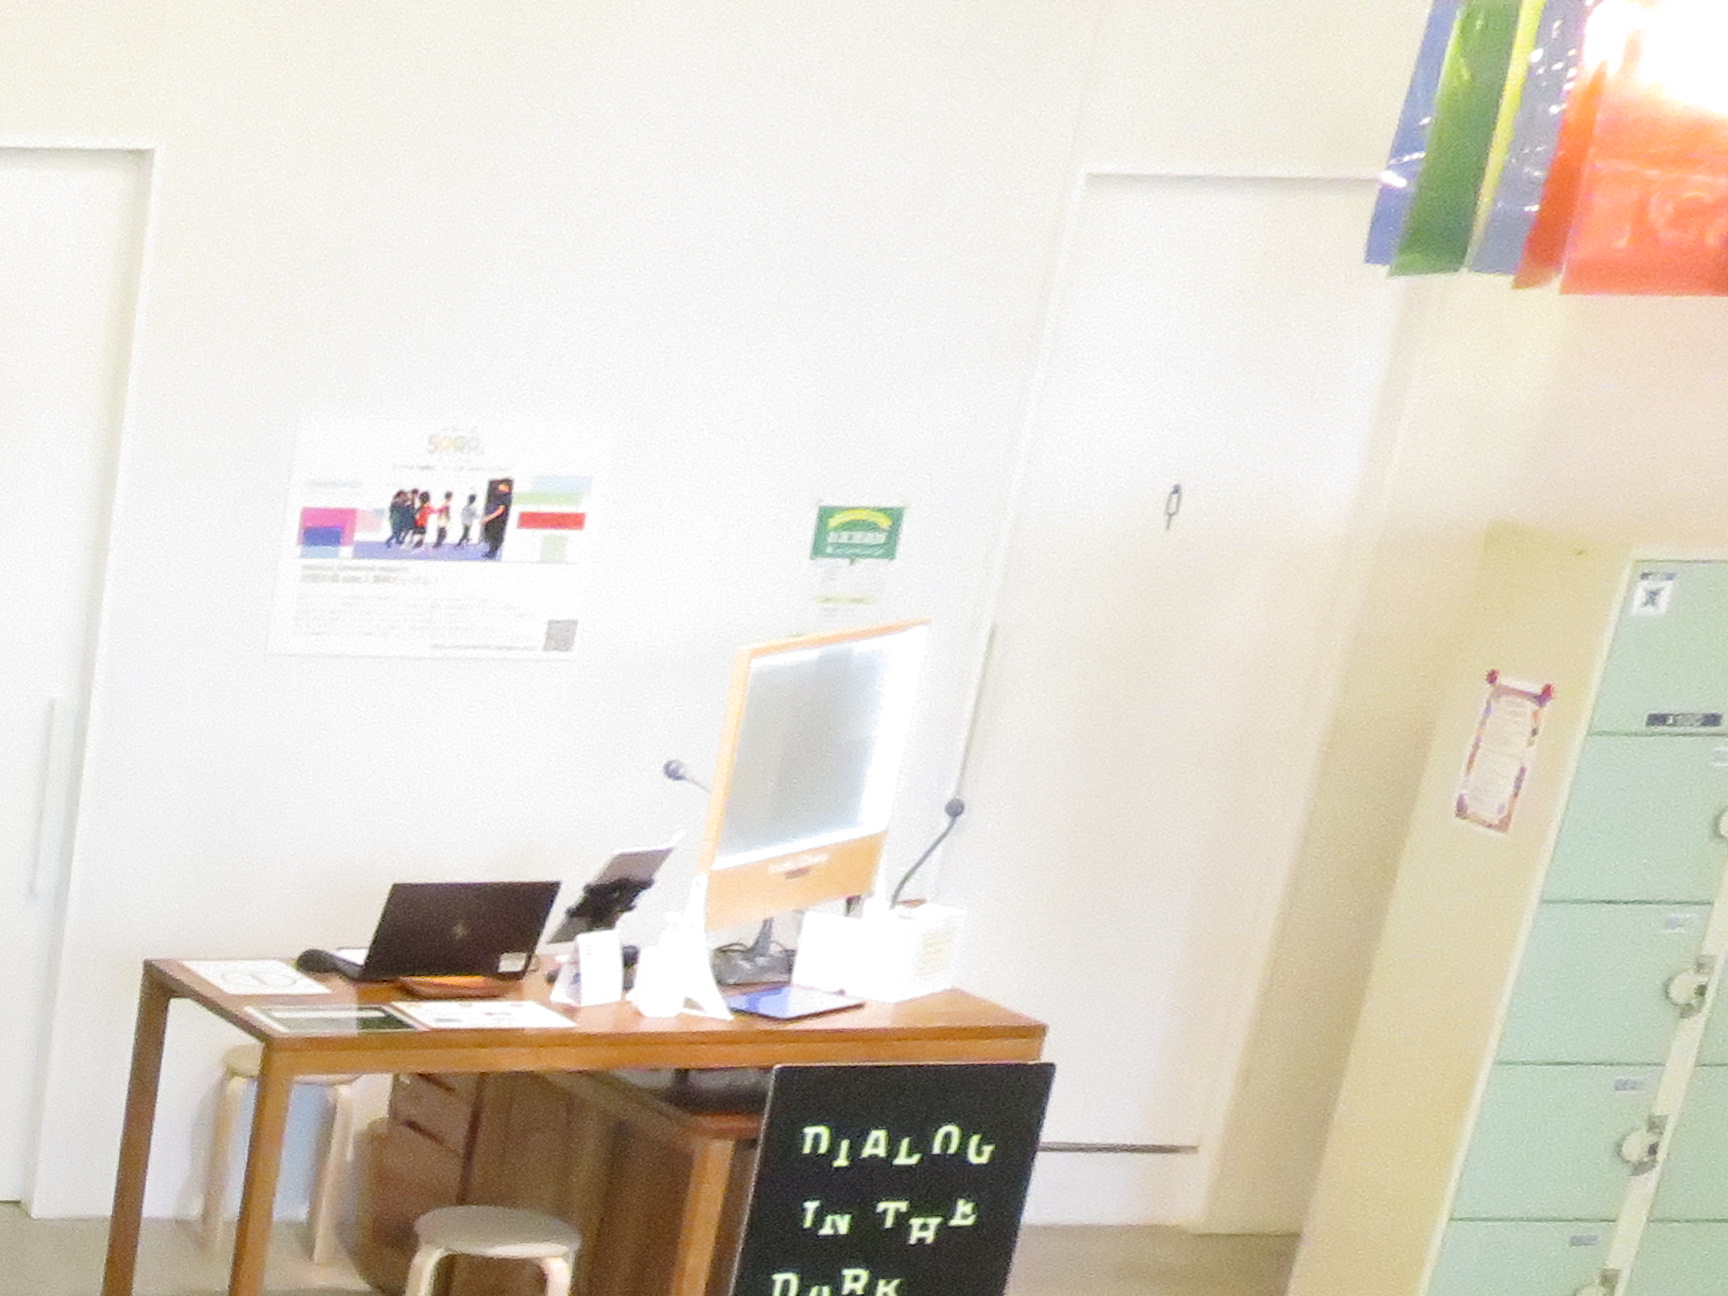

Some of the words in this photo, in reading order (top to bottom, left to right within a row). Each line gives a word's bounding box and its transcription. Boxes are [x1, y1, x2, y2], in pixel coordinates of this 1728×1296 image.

[801, 1122, 996, 1168] DIALOG
[802, 1199, 852, 1236] IN
[875, 1198, 977, 1245] THE
